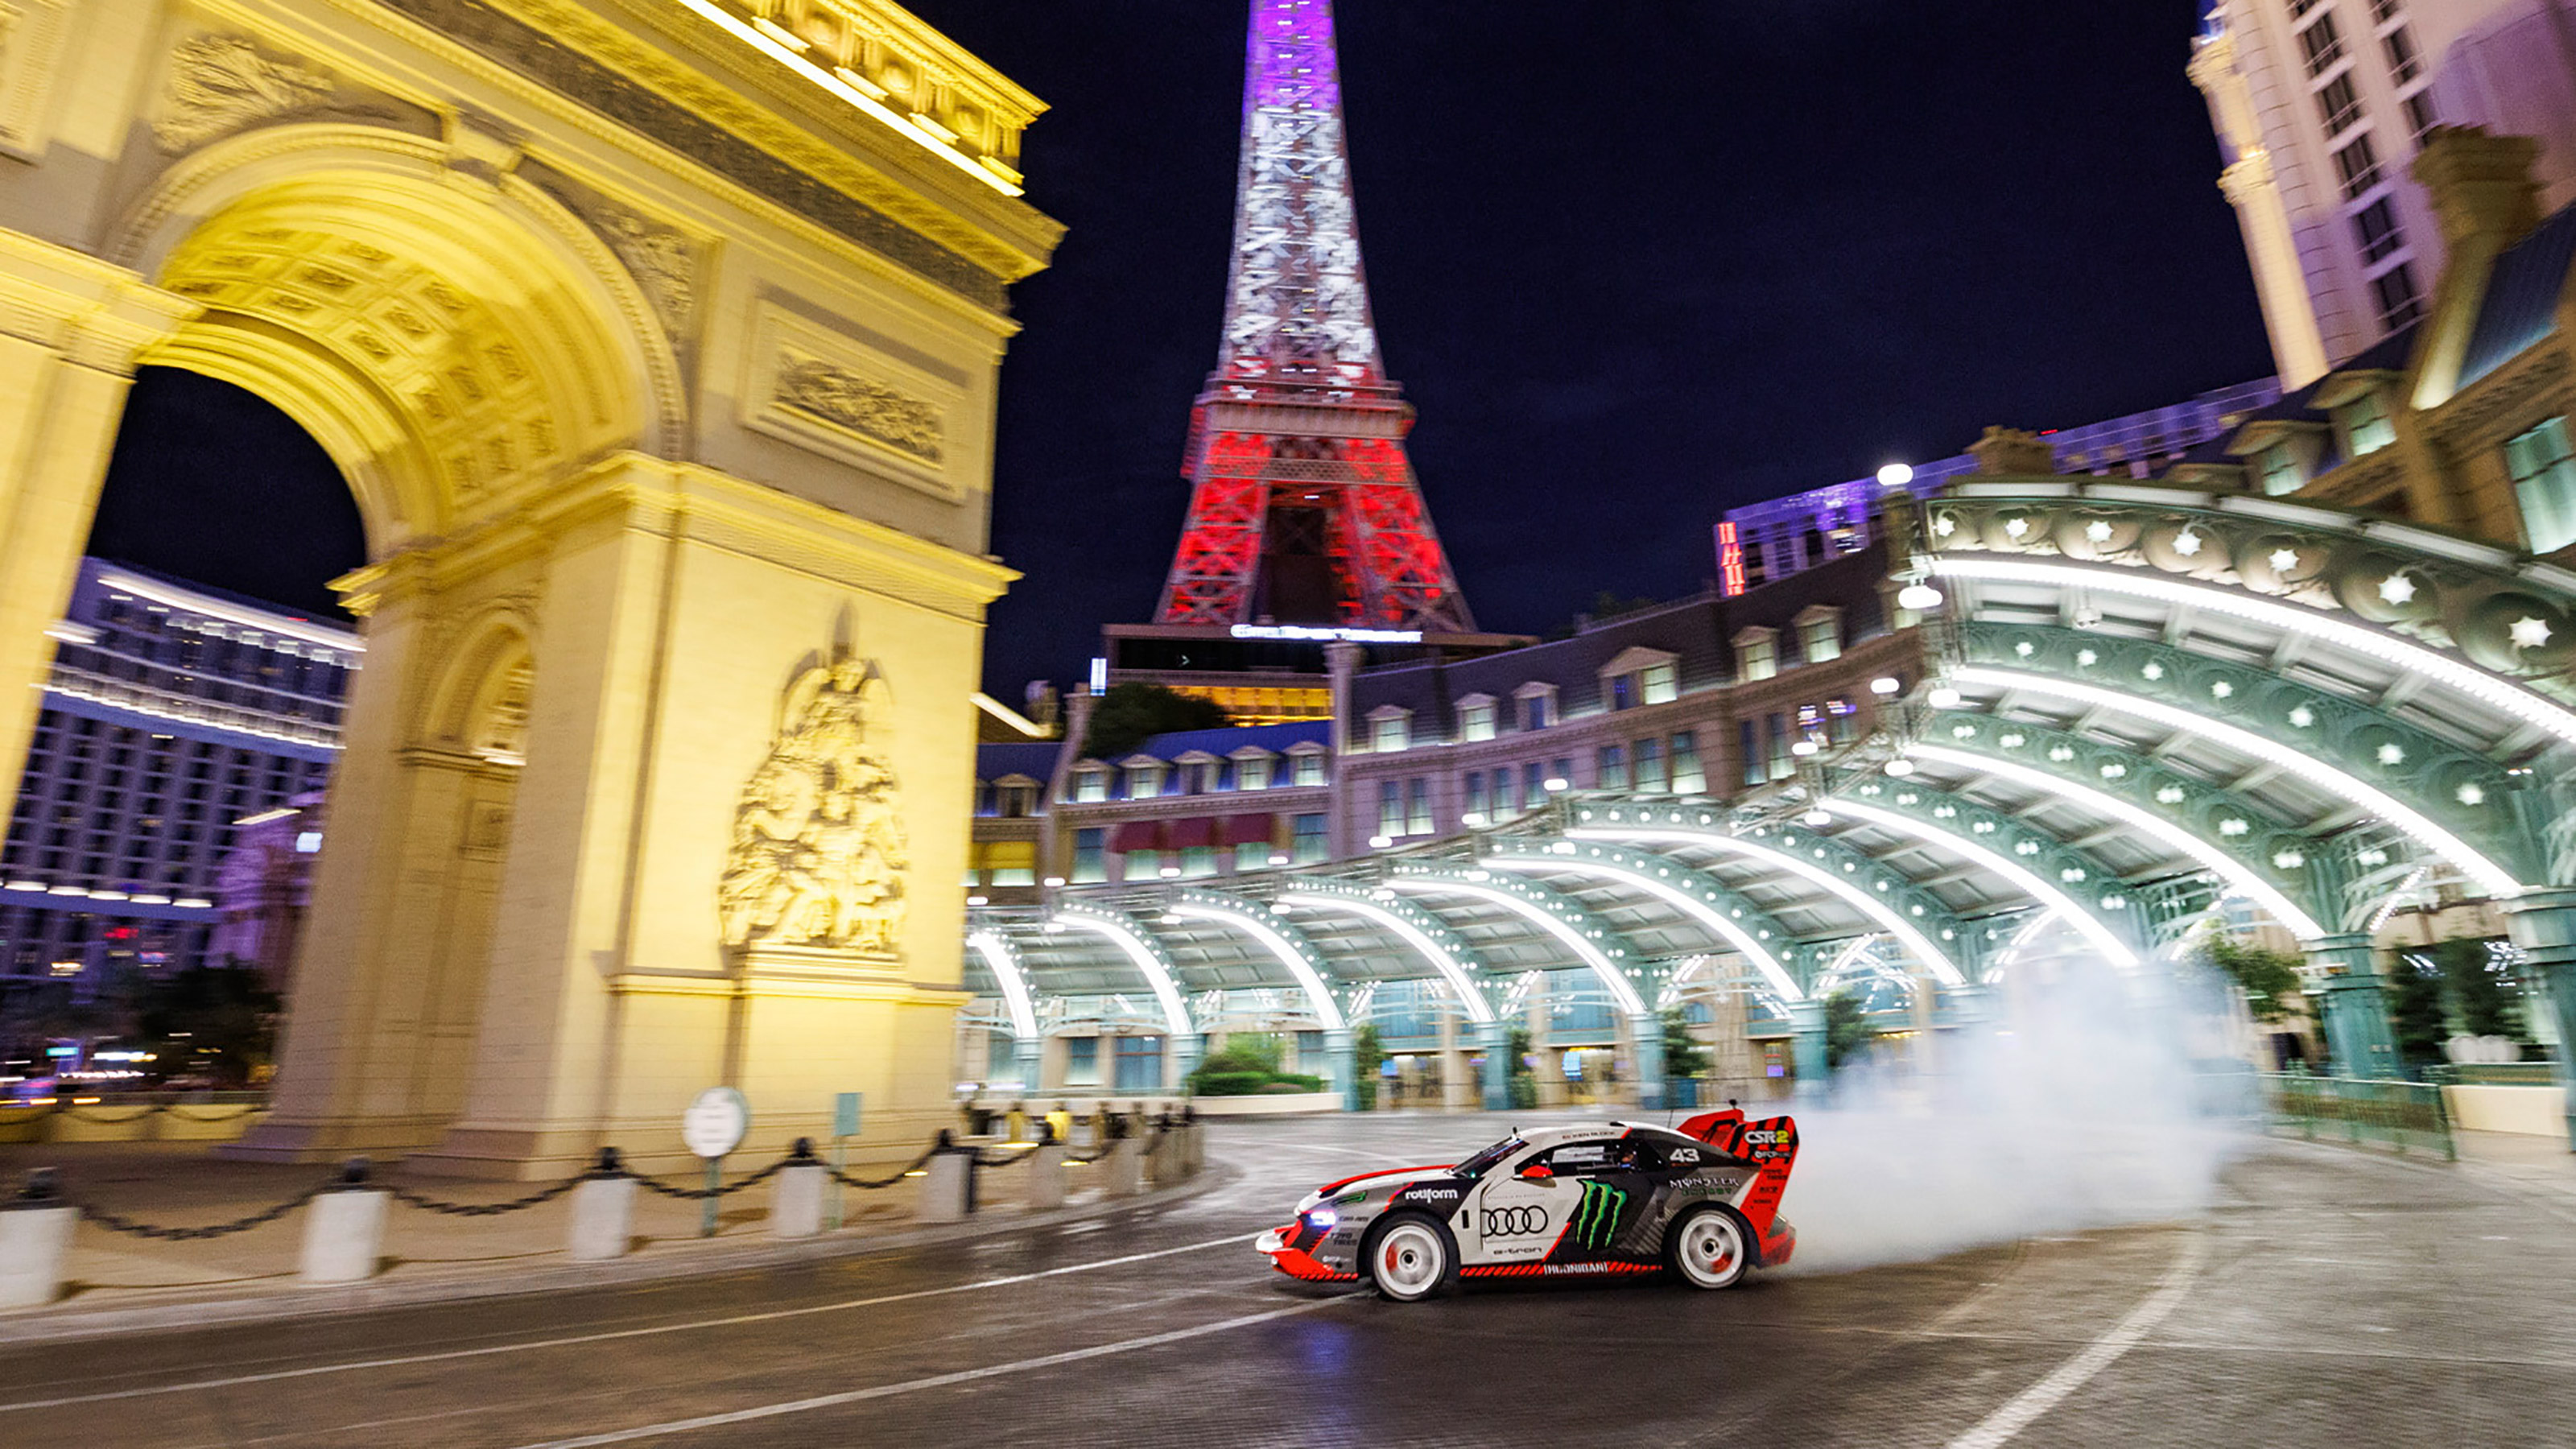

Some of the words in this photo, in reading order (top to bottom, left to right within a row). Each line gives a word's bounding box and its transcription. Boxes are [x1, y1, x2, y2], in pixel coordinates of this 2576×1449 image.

[1744, 1130, 1790, 1144] CSR2
[1669, 1148, 1701, 1162] 43
[1669, 1178, 1740, 1189] MONSTER
[1405, 1188, 1459, 1203] rotiform
[1493, 1246, 1542, 1255] e-tron
